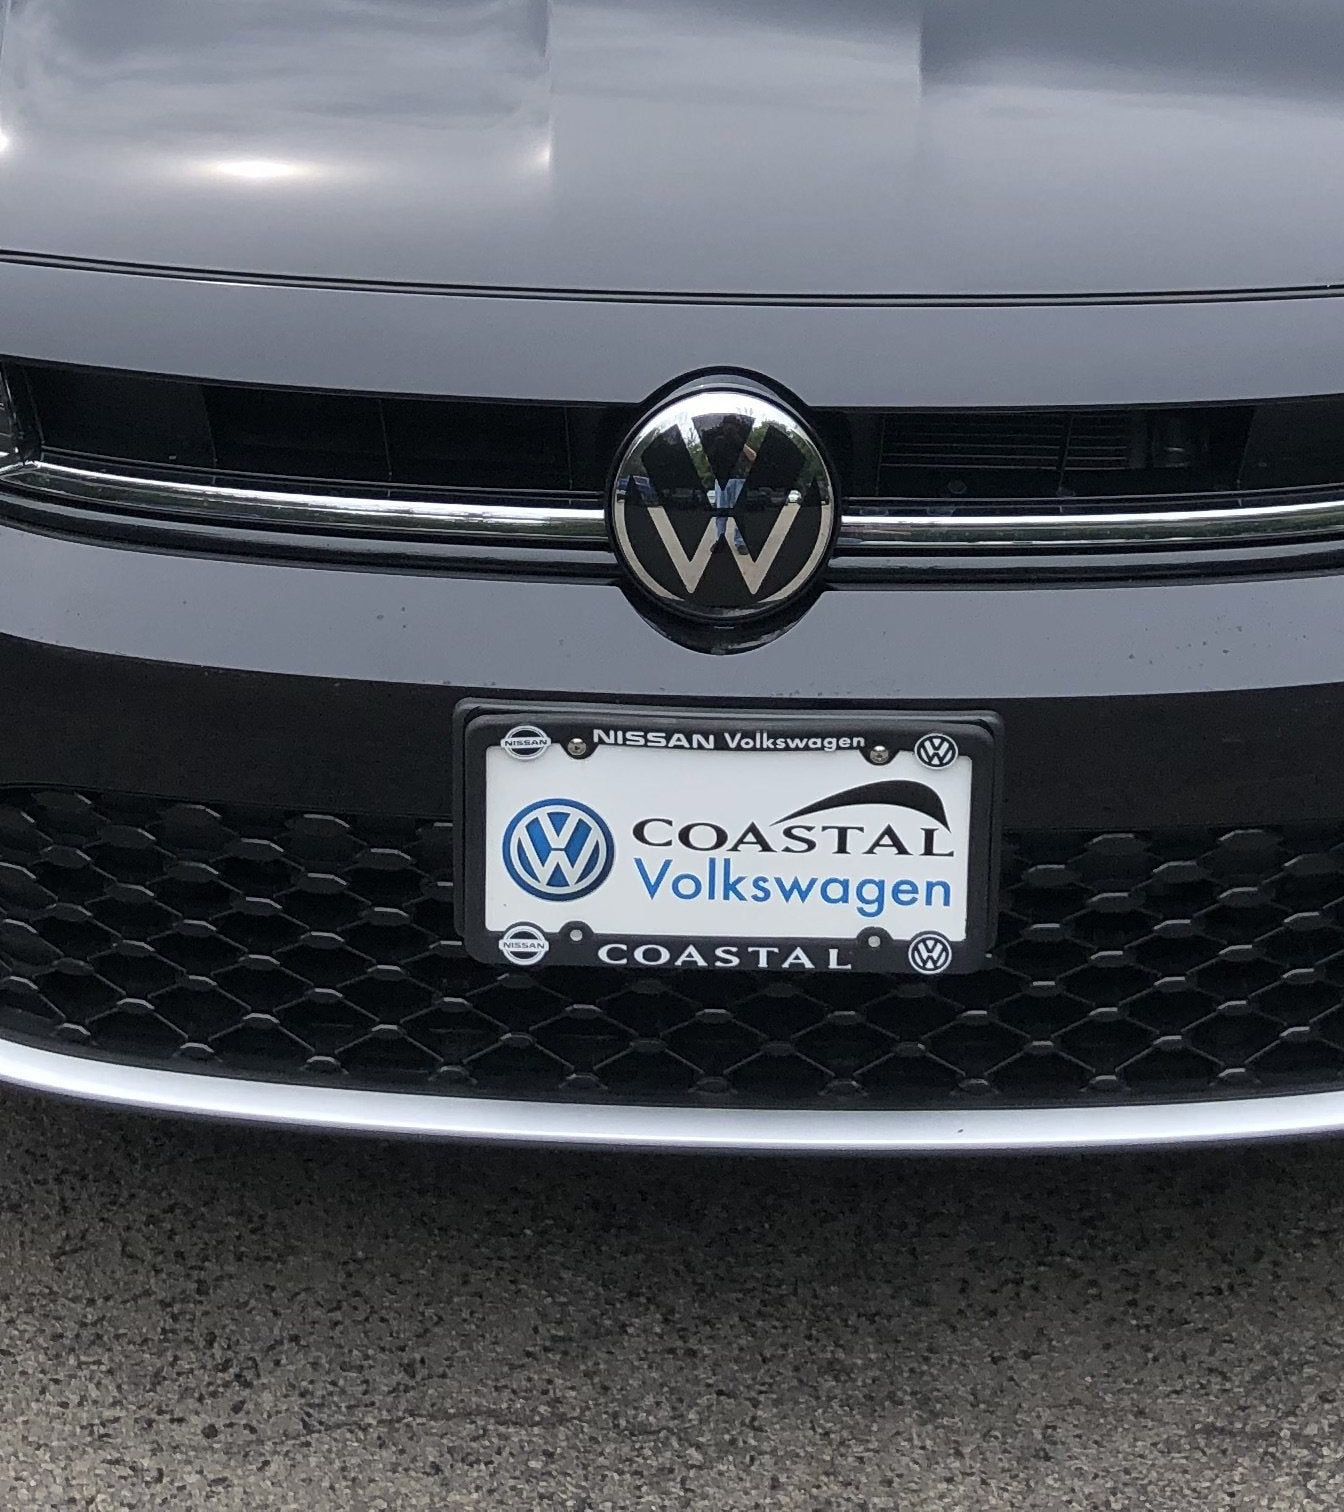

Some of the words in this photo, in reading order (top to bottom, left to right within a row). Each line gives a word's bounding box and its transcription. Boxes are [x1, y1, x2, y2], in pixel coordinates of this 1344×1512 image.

[503, 737, 548, 748] NISSAN
[592, 729, 715, 749] NISSAN
[723, 731, 866, 751] Volkswagen
[632, 818, 954, 858] COASTAL
[633, 857, 952, 917] Volkswagen
[501, 939, 547, 950] NISSAN
[598, 943, 853, 970] COASTAL
